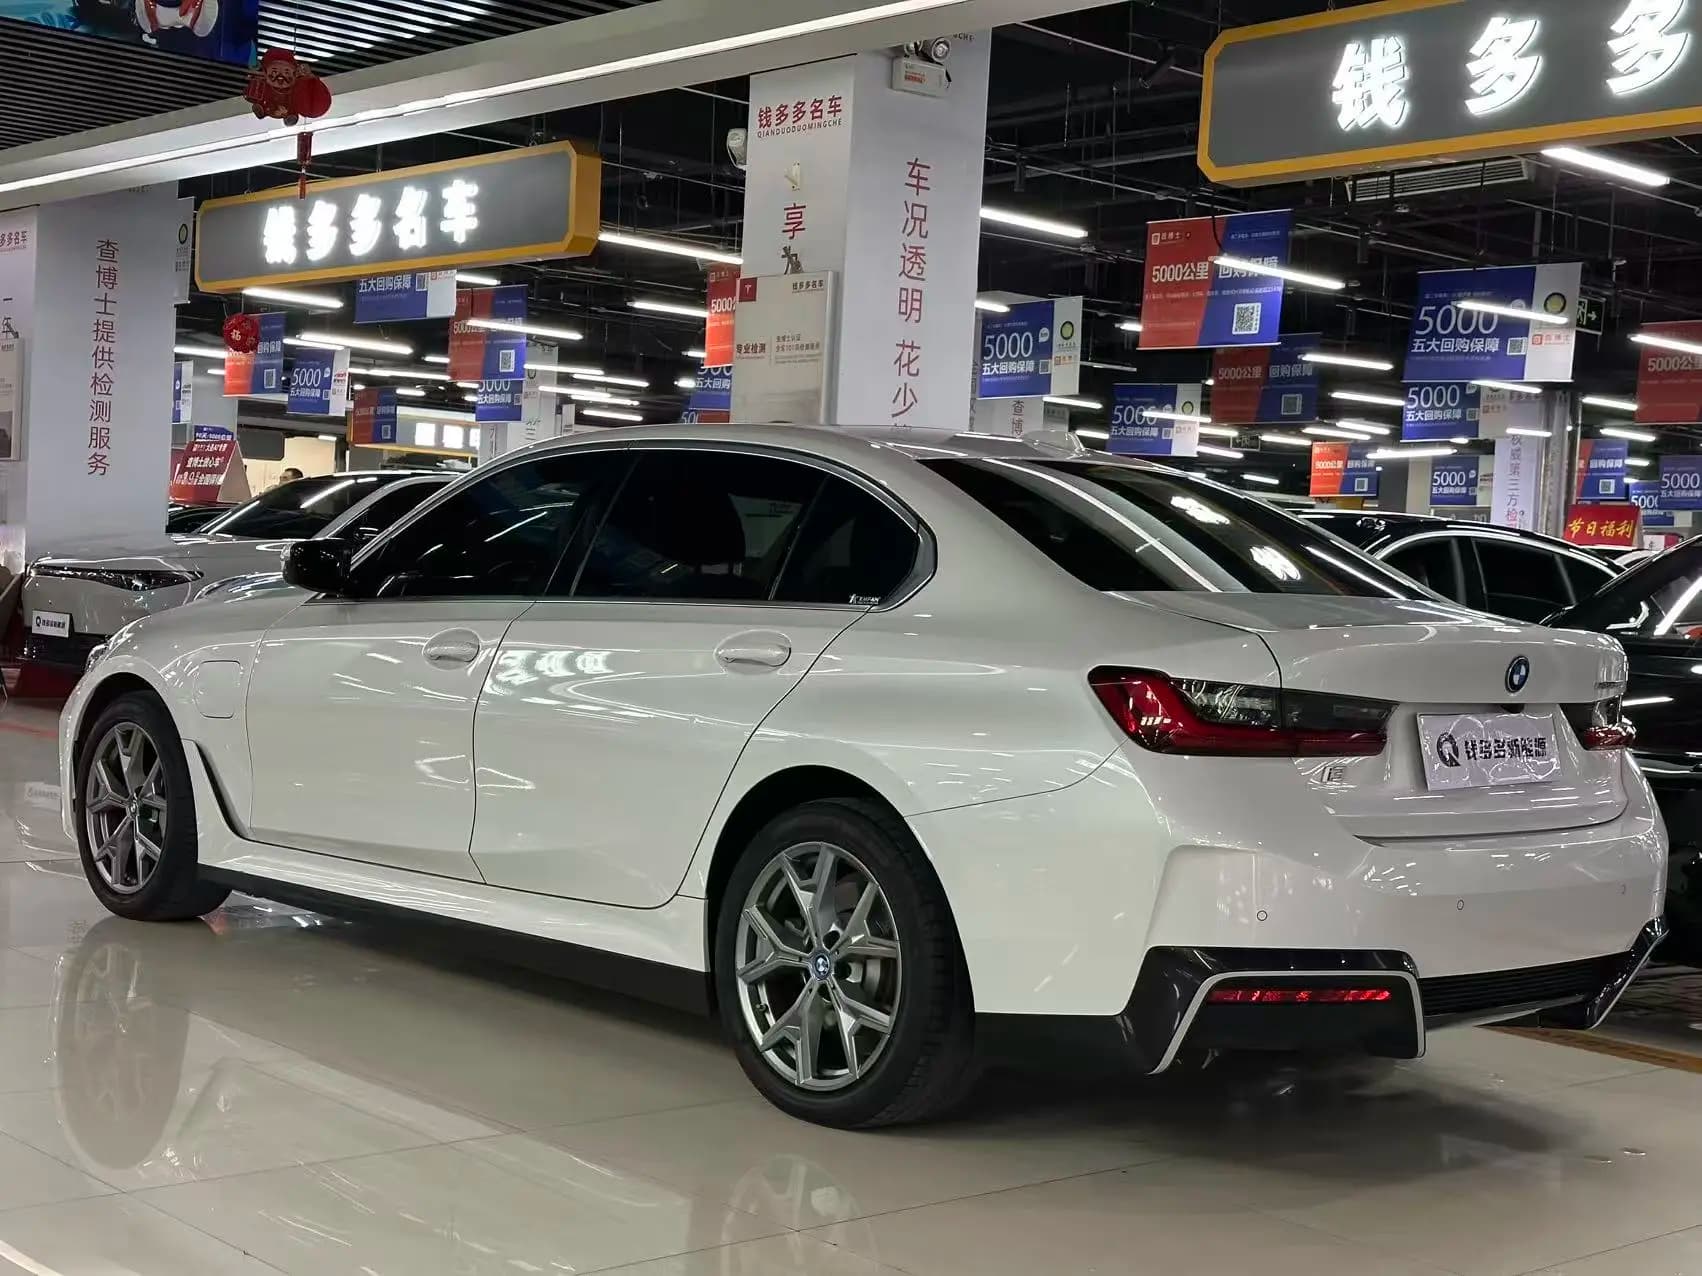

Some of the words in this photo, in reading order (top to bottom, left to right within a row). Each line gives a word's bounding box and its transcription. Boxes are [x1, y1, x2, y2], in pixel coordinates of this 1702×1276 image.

[1332, 0, 1690, 130] 钱多多
[758, 95, 842, 129] 钱多多名车
[757, 118, 842, 139] QIANDUODUOMINGCHE
[263, 179, 479, 265] 钱多多名车
[898, 157, 931, 323] 车况透明
[1152, 261, 1209, 283] 5000公里
[359, 274, 411, 293] 五大回购保障
[1415, 304, 1499, 335] 5000
[736, 343, 767, 354] 专业检测
[984, 332, 1034, 360] 5000
[1411, 337, 1500, 353] 五大回购保障
[87, 239, 119, 477] 查博士提供检测服务
[982, 360, 1034, 375] 五大回购保障
[291, 368, 321, 387] 5000
[1218, 366, 1262, 380] 5000公里
[1269, 364, 1313, 378] 回购保障
[891, 339, 921, 427] 花少
[477, 393, 512, 405] 五大回购保障
[1406, 385, 1460, 409] 5000
[1406, 408, 1462, 421] 五大回购保障
[1111, 427, 1158, 437] 五大回购保障
[1433, 472, 1466, 486] 5000
[1661, 473, 1701, 489] 5000
[1568, 518, 1633, 539] 节日福利
